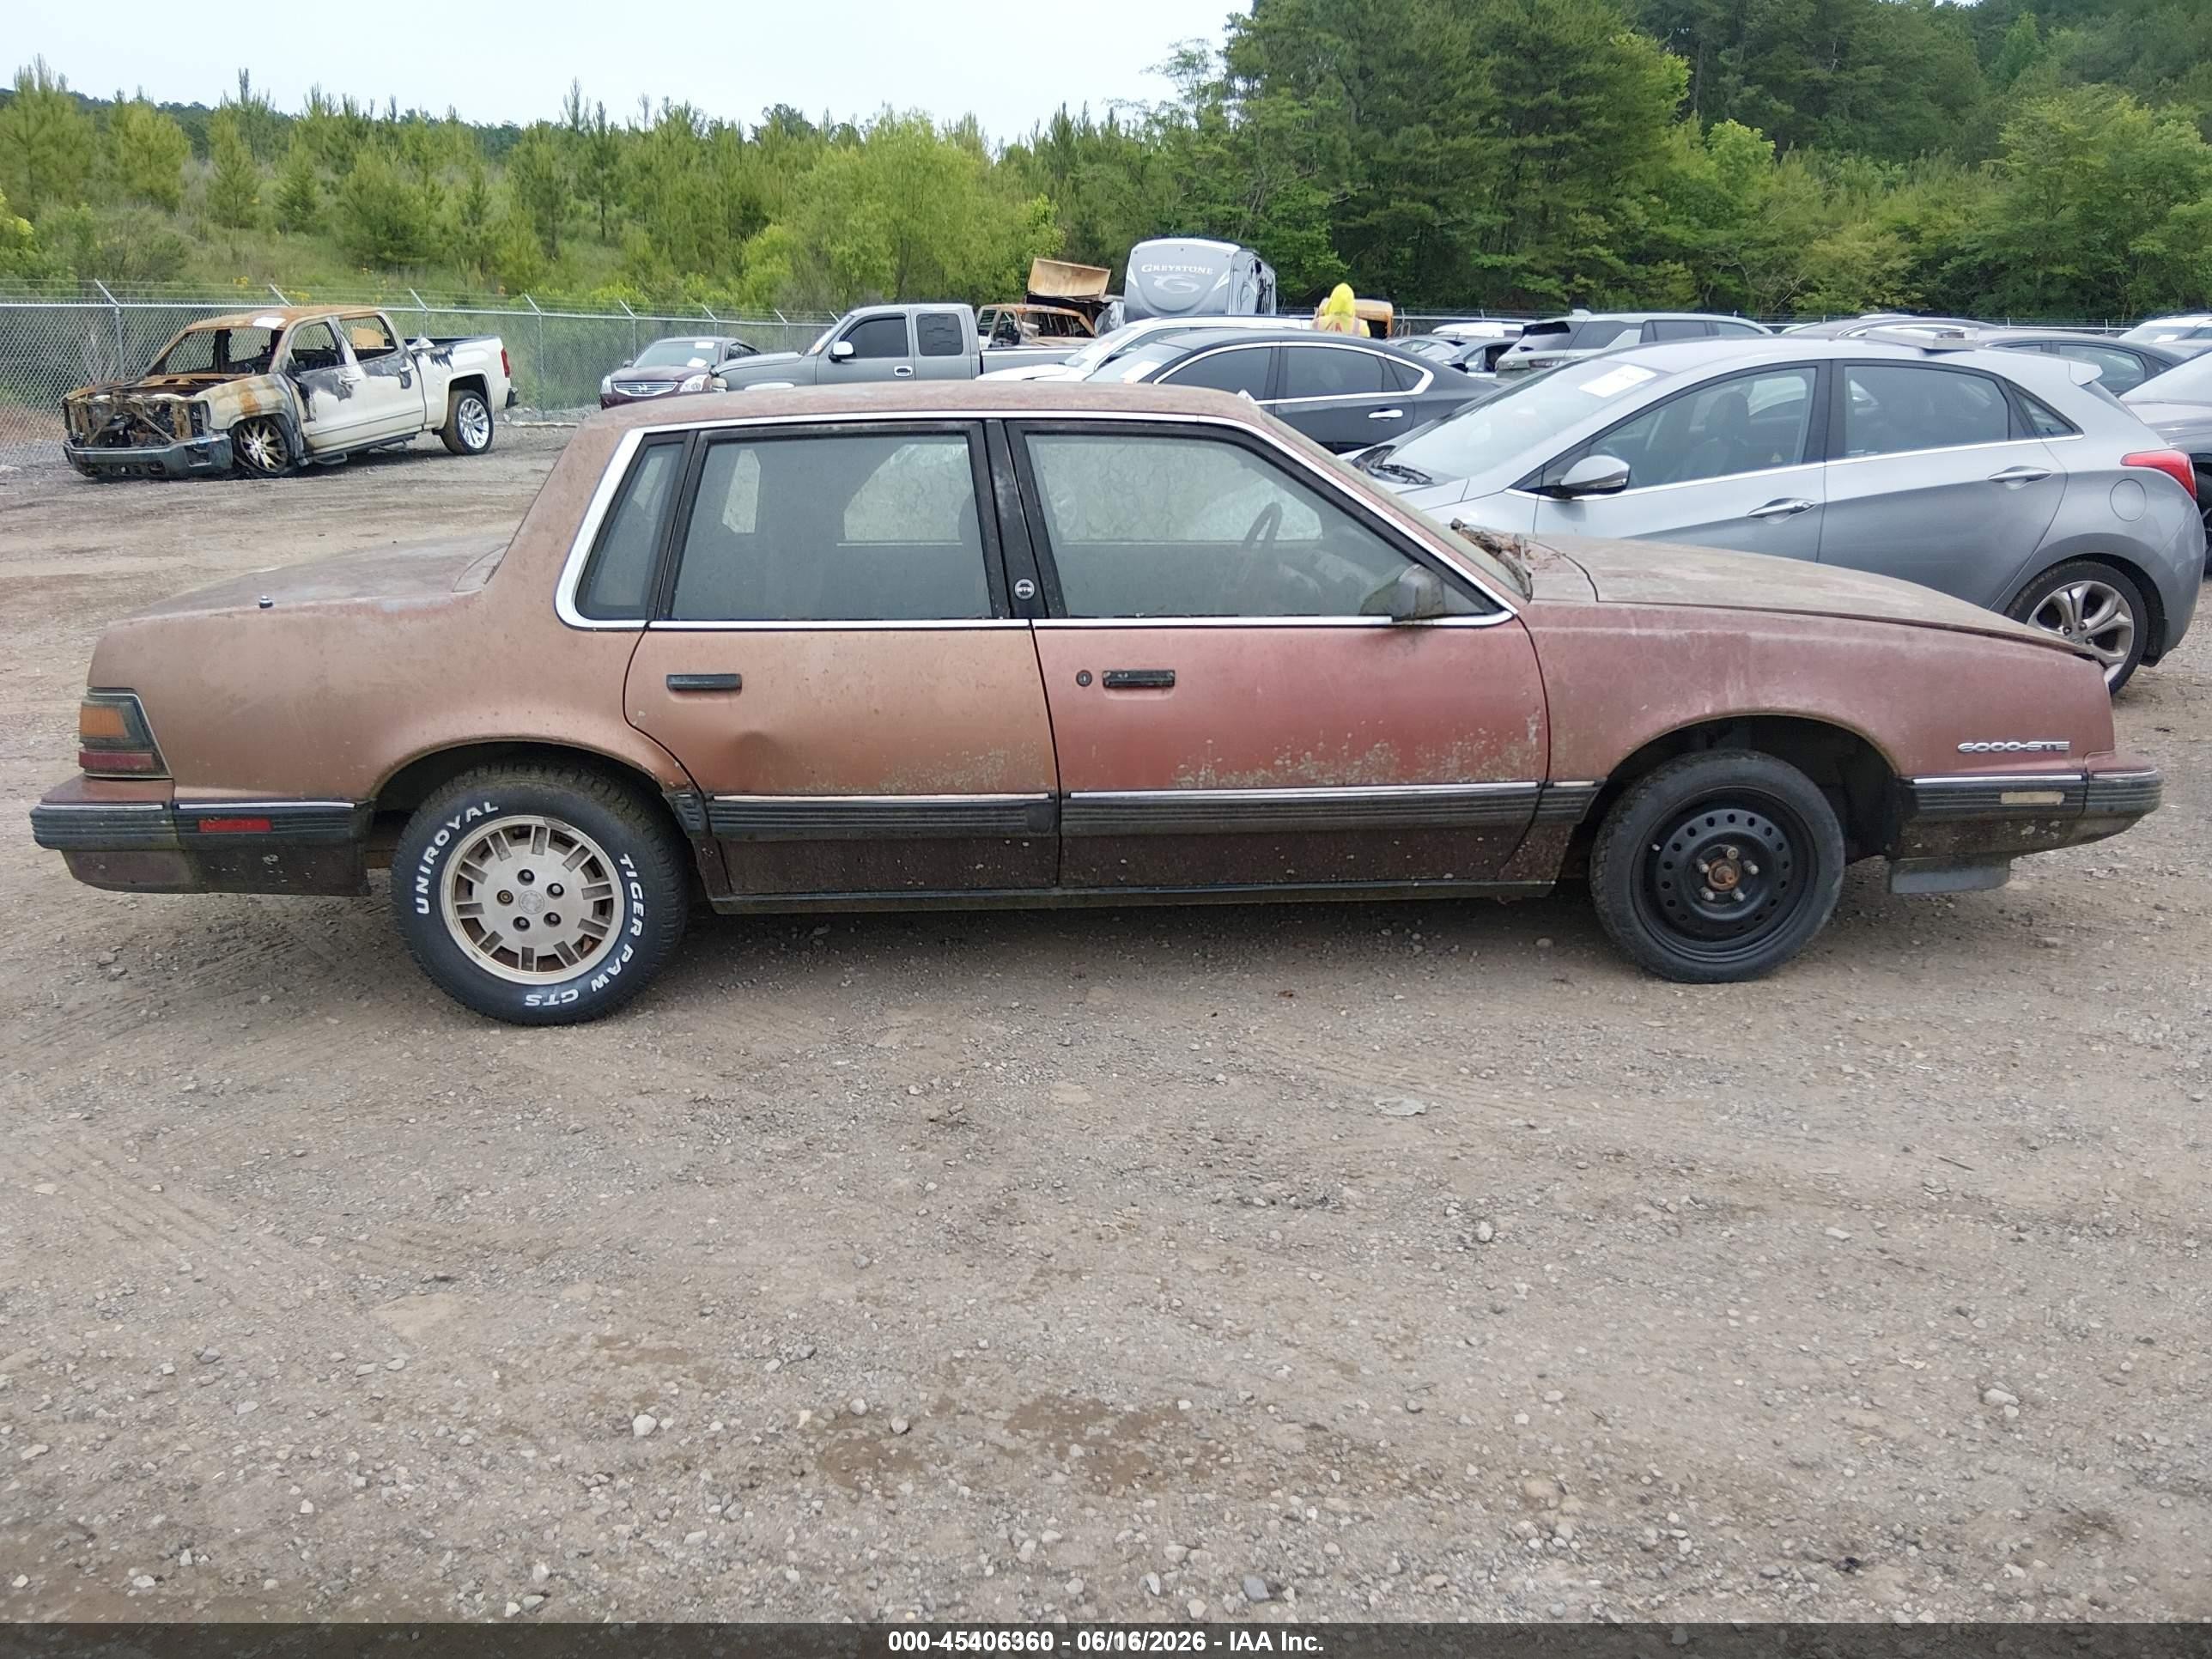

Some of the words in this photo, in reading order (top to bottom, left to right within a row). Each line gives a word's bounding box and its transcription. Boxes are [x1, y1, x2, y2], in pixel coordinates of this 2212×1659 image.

[1141, 264, 1213, 275] GREYSTONE
[416, 802, 499, 915] UNIROYAL
[619, 854, 645, 936] TIGER
[590, 944, 634, 992] PAW
